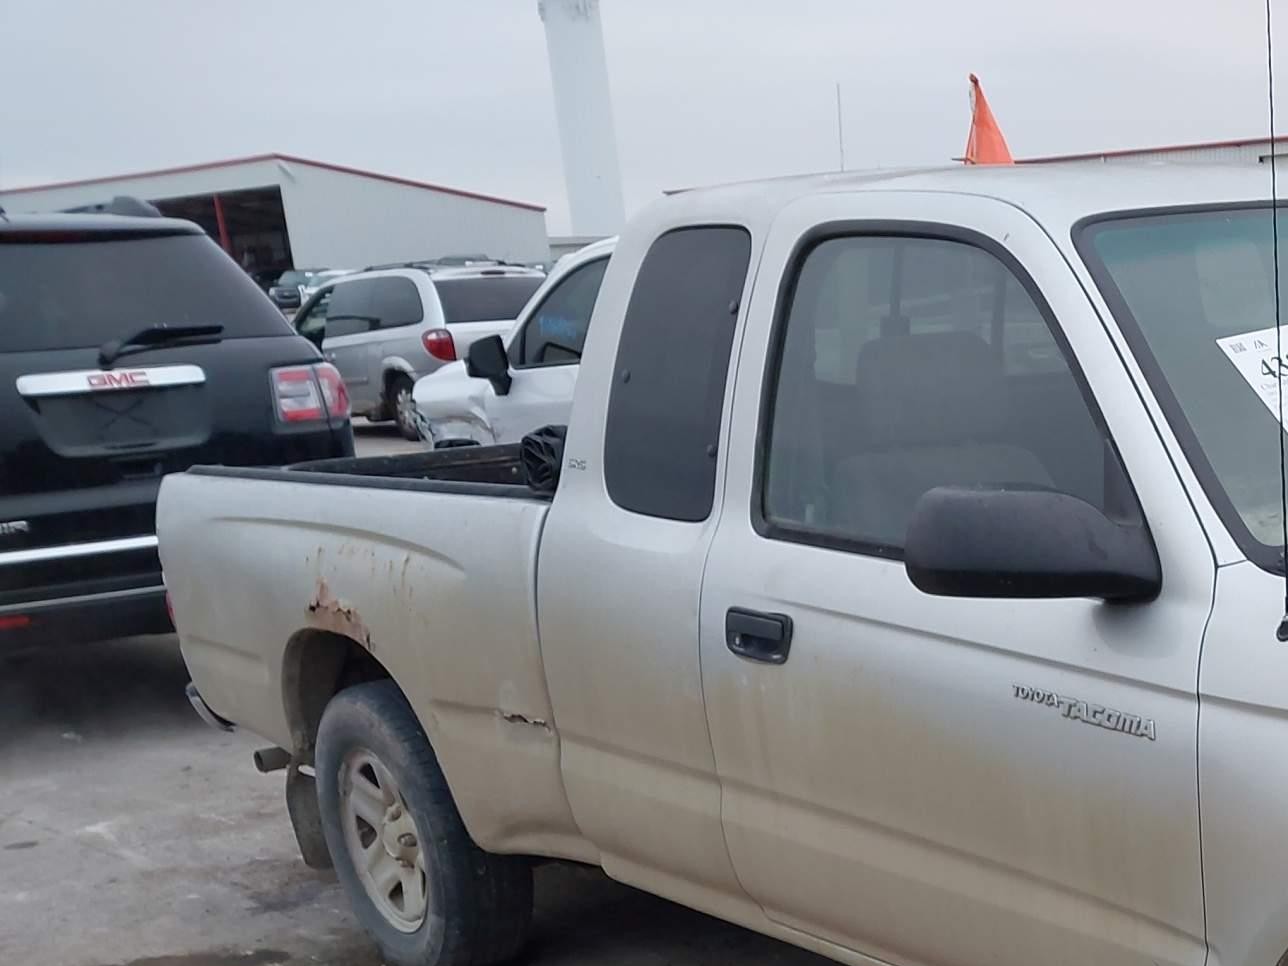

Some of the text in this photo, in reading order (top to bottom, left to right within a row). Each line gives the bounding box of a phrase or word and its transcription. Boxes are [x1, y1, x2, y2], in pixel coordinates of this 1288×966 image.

[87, 372, 149, 388] GMC
[1012, 685, 1156, 741] TOYOTA TACOMA
